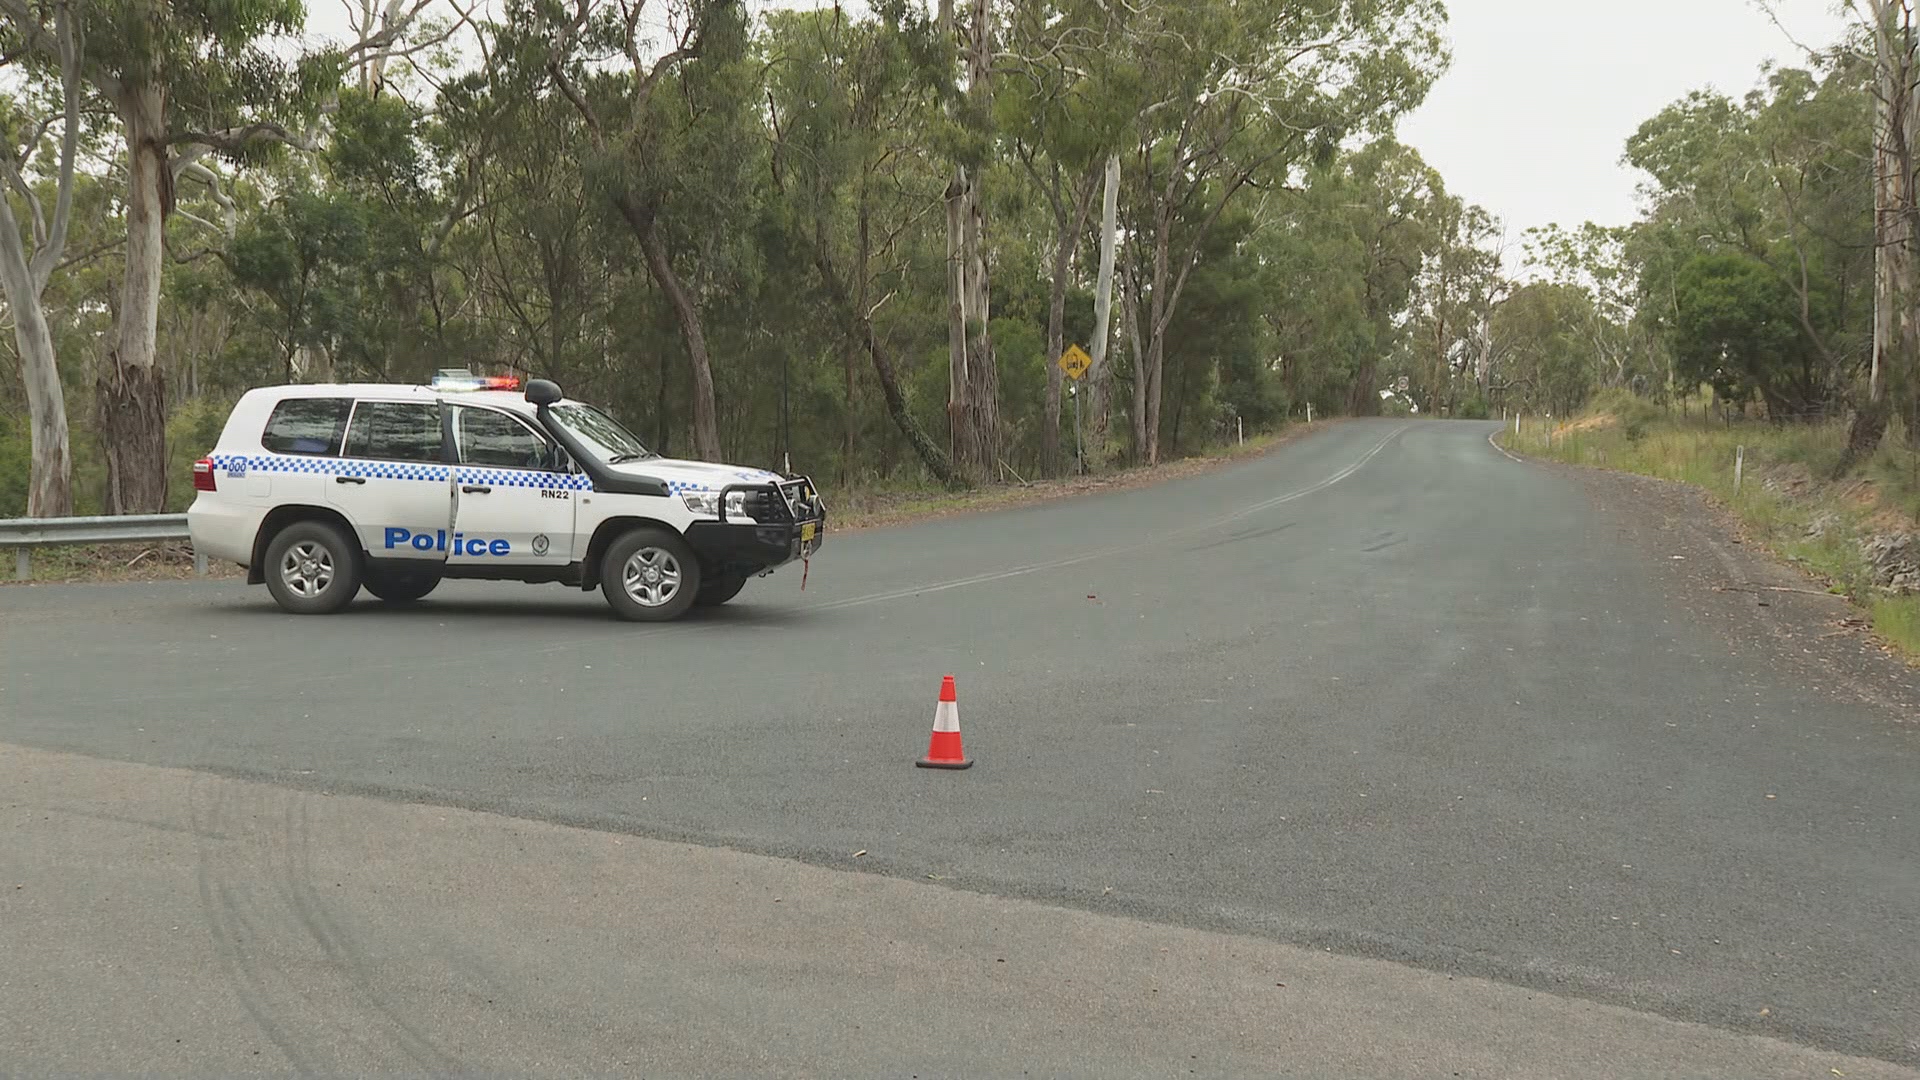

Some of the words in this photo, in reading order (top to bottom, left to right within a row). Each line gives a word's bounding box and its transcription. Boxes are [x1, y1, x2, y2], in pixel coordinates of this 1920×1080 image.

[228, 462, 247, 472] 000
[541, 490, 569, 499] RN22
[384, 527, 511, 556] Police
